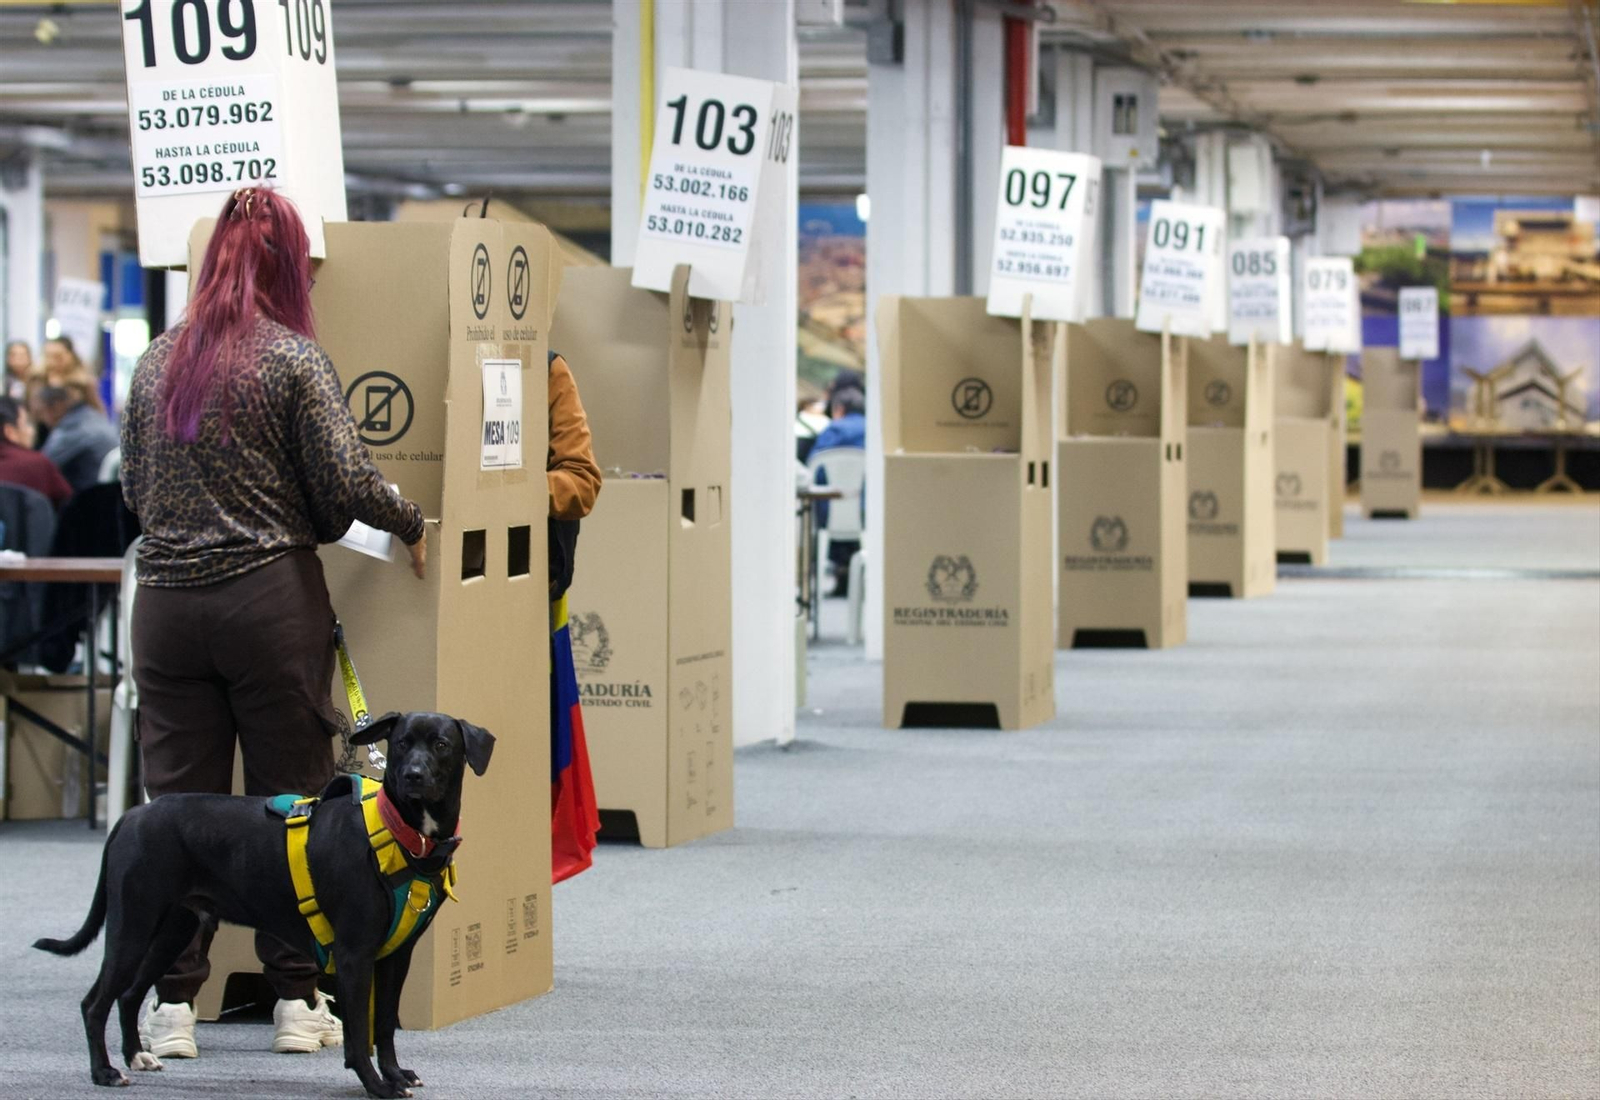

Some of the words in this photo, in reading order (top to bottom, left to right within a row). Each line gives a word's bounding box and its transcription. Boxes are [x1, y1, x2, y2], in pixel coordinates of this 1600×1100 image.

[124, 0, 257, 67] 109
[278, 0, 327, 64] 109
[162, 90, 177, 101] DE
[182, 88, 195, 100] LA
[199, 85, 245, 99] CÉDULA
[138, 101, 273, 130] 53.079.962
[667, 94, 758, 156] 103
[155, 147, 192, 159] HASTA
[196, 145, 210, 156] LA
[213, 141, 260, 155] CÉDULA
[768, 109, 793, 164] 103
[142, 158, 277, 187] 53.098.702
[674, 163, 685, 172] DE
[687, 165, 697, 175] LA
[653, 173, 749, 202] 53.002.166
[1006, 168, 1077, 210] 097
[660, 204, 686, 215] HASTA
[689, 207, 699, 217] LA
[647, 215, 743, 244] 53.010.282
[1154, 218, 1205, 252] 091
[1232, 251, 1277, 276] 085
[1308, 268, 1348, 290] 079
[484, 420, 505, 445] MESA
[506, 420, 520, 445] 109
[376, 453, 393, 461] uso
[395, 451, 407, 461] de
[409, 451, 444, 462] celular
[893, 605, 1009, 619] REGISTRADURÍA
[581, 698, 622, 707] ESTADO
[625, 699, 652, 708] CIVIL
